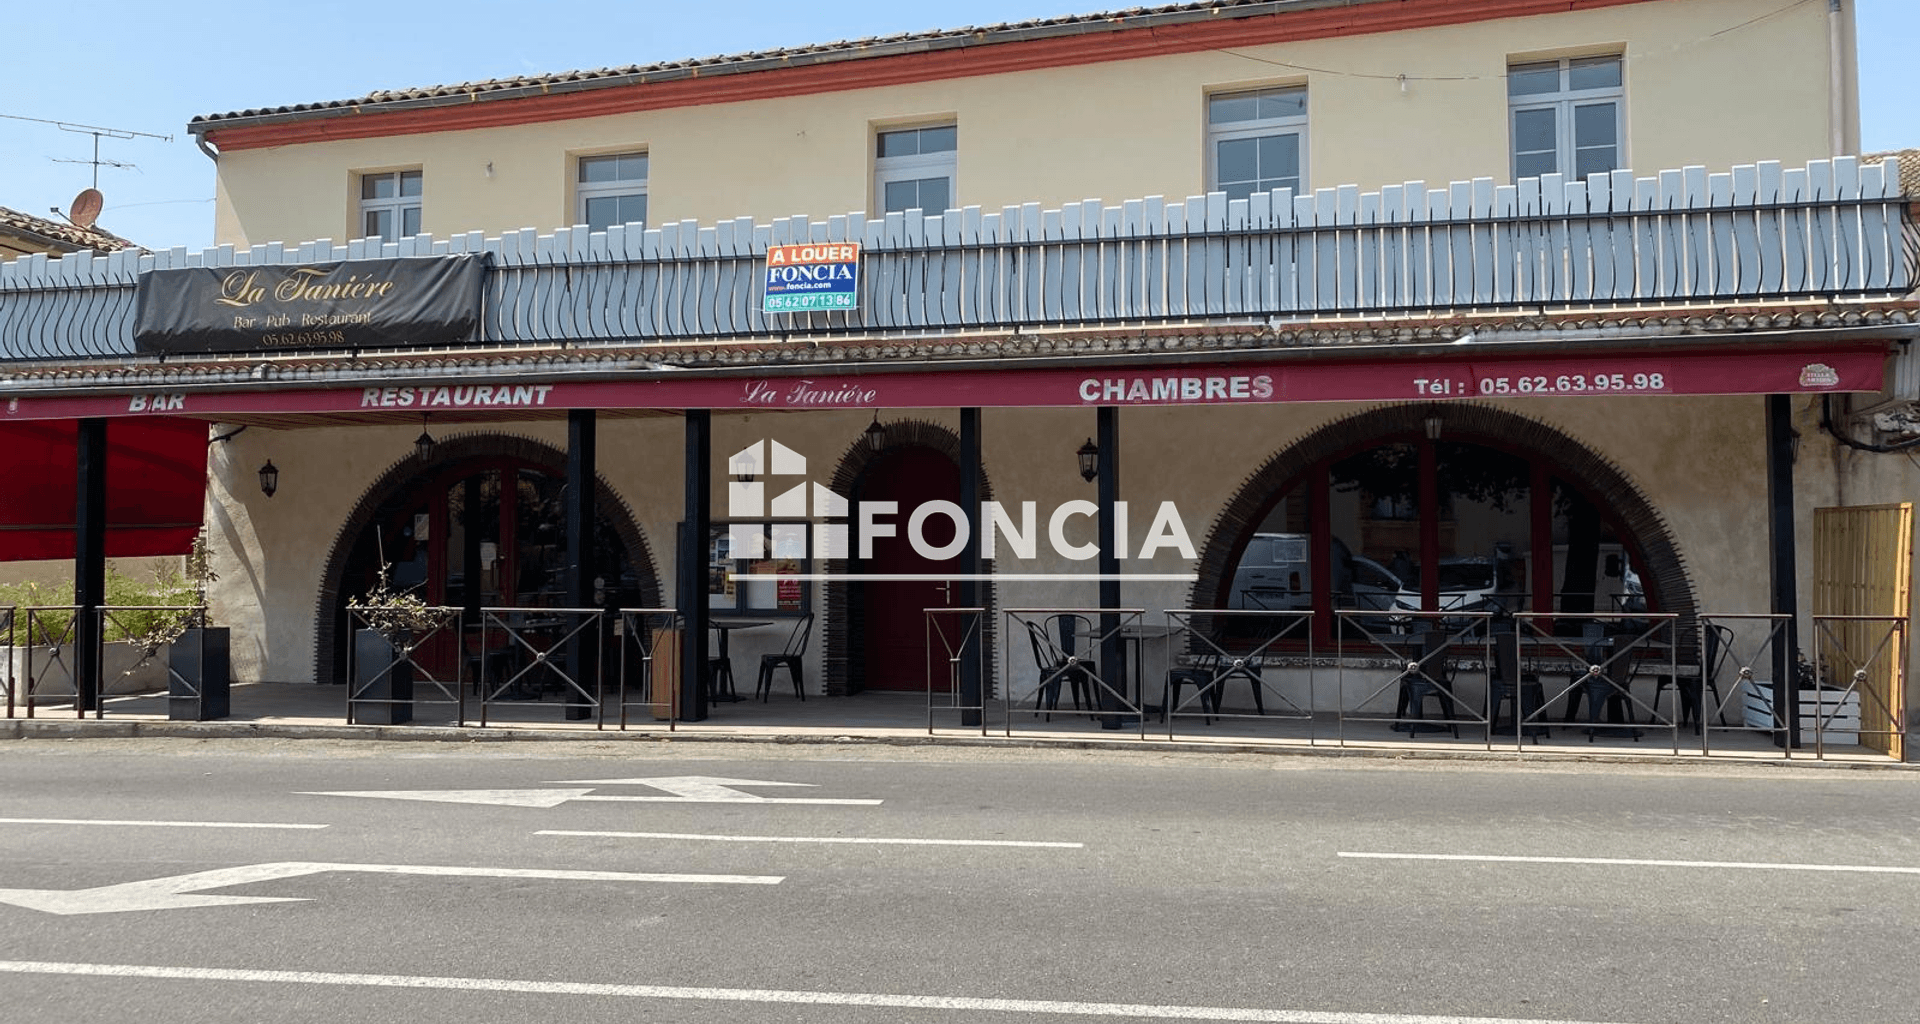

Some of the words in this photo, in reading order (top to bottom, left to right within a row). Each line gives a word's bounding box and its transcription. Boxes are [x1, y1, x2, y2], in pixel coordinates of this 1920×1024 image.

[771, 249, 785, 263] A
[791, 246, 853, 262] LOUER
[769, 264, 853, 283] FONCIA
[214, 269, 267, 307] La
[769, 298, 783, 308] 05
[785, 297, 799, 307] 62
[802, 296, 816, 307] 07
[820, 295, 833, 306] 13
[836, 294, 850, 305] 86
[234, 316, 256, 329] Bar
[266, 313, 290, 328] Pub
[302, 311, 371, 326] Restaurant
[262, 331, 345, 346] 05.62.63.95.98
[740, 380, 777, 403] La
[1079, 375, 1274, 402] CHAMBRES
[1414, 379, 1450, 394] Tél
[1480, 373, 1665, 395] 05.62.63.95.98
[129, 394, 186, 412] BAR
[361, 385, 554, 407] RESTAURANT
